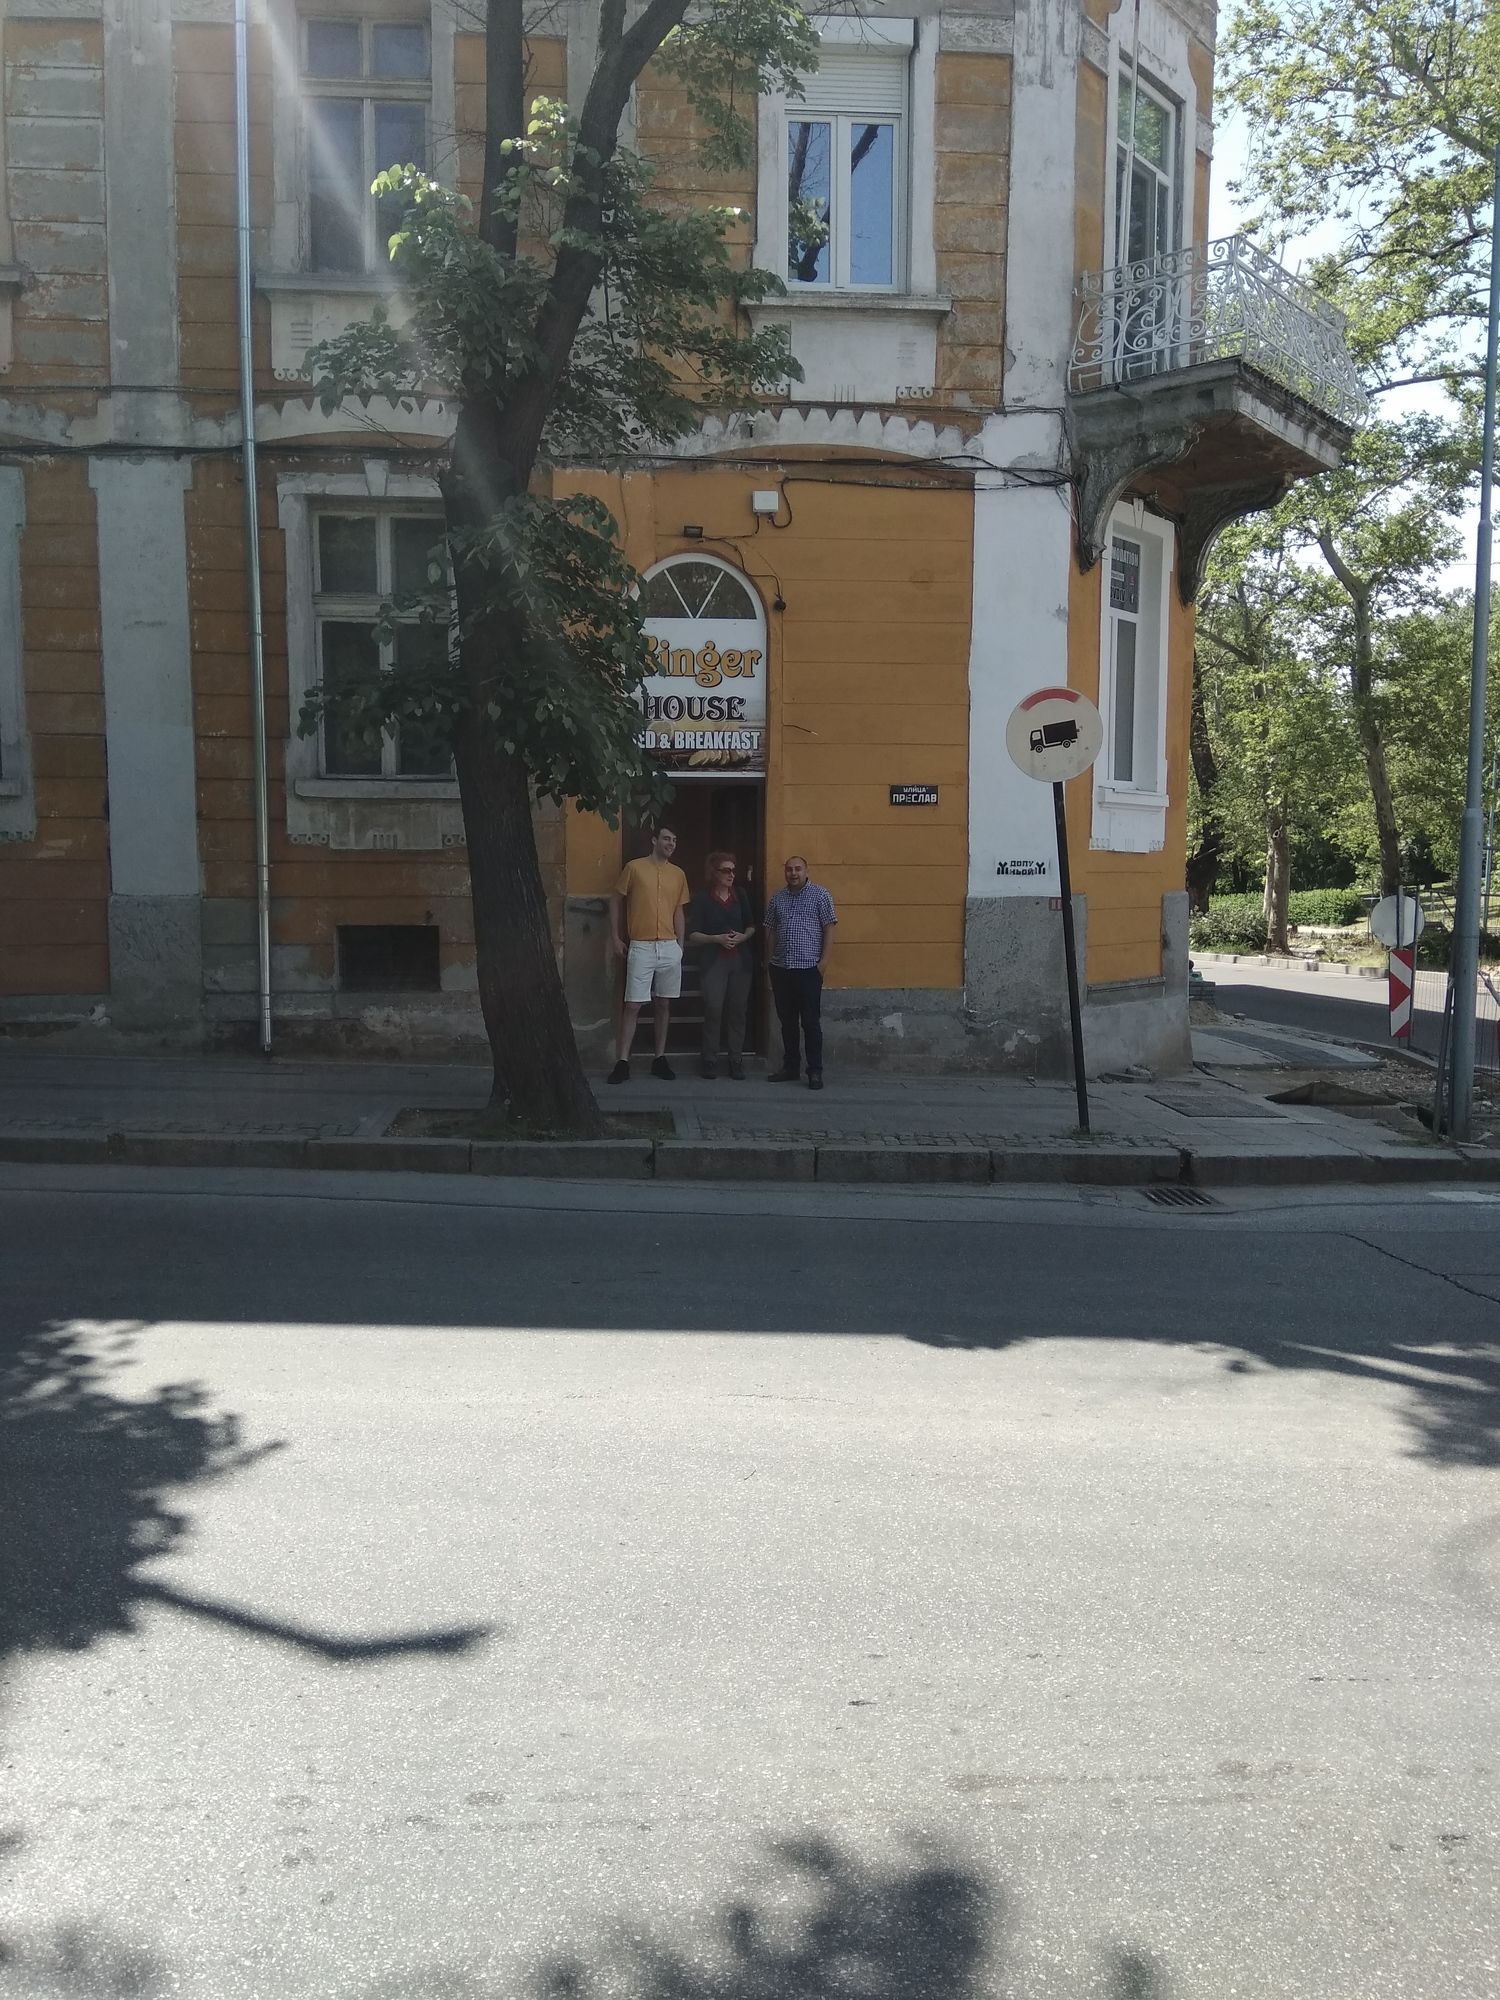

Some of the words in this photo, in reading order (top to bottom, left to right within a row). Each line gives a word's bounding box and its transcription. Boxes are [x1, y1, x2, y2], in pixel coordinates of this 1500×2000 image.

[641, 695, 748, 722] HOUSE
[632, 730, 656, 749] ED
[659, 733, 671, 749] &
[674, 731, 761, 750] BREAKFAST
[892, 793, 937, 803] ПРЕСЛАВ
